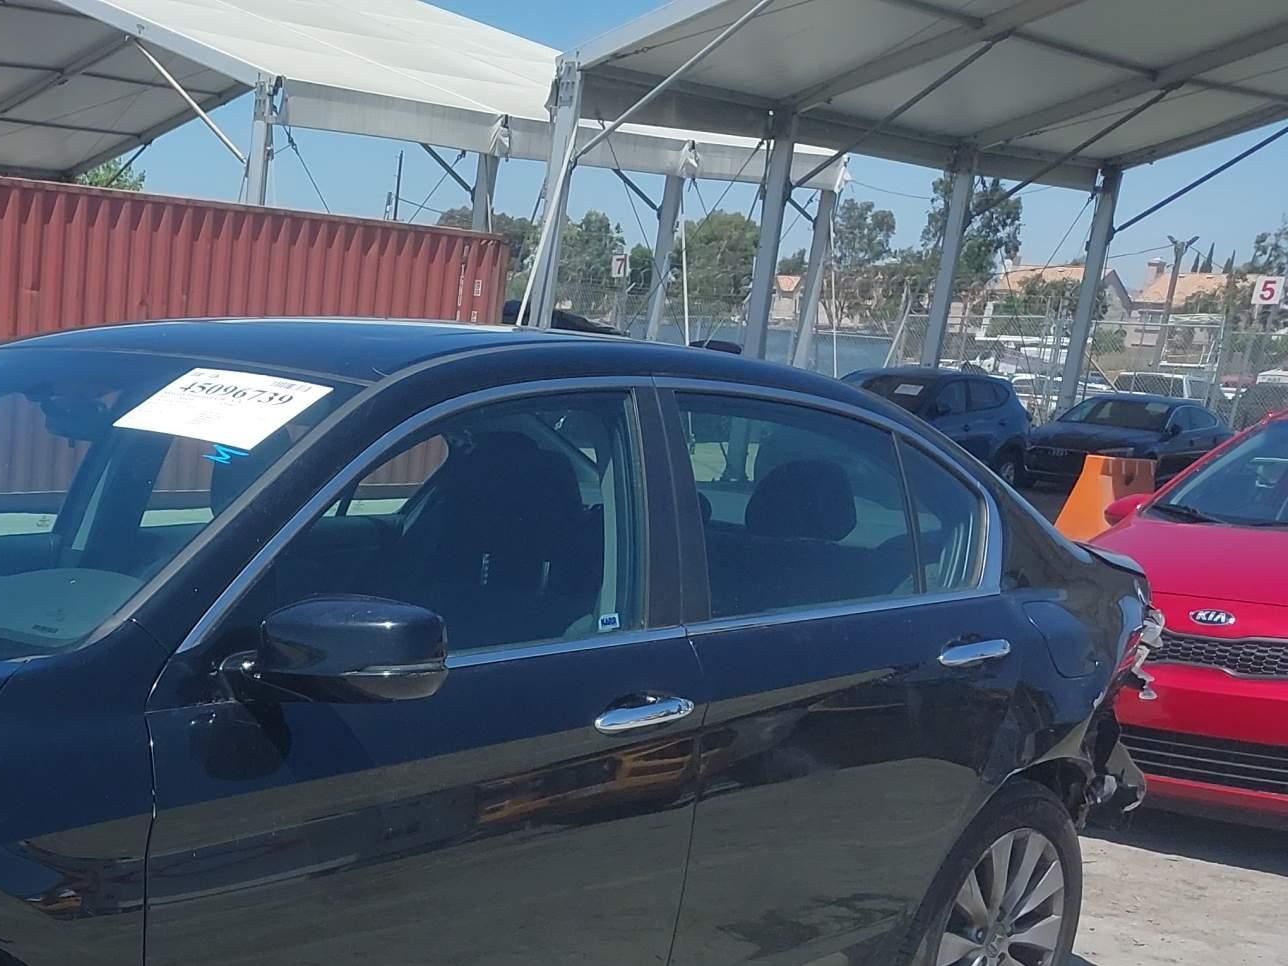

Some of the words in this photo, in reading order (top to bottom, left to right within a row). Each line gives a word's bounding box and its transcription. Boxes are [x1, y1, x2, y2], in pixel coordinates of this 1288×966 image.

[1259, 280, 1277, 301] 5
[179, 381, 294, 406] 45096739
[1195, 610, 1227, 623] KIA
